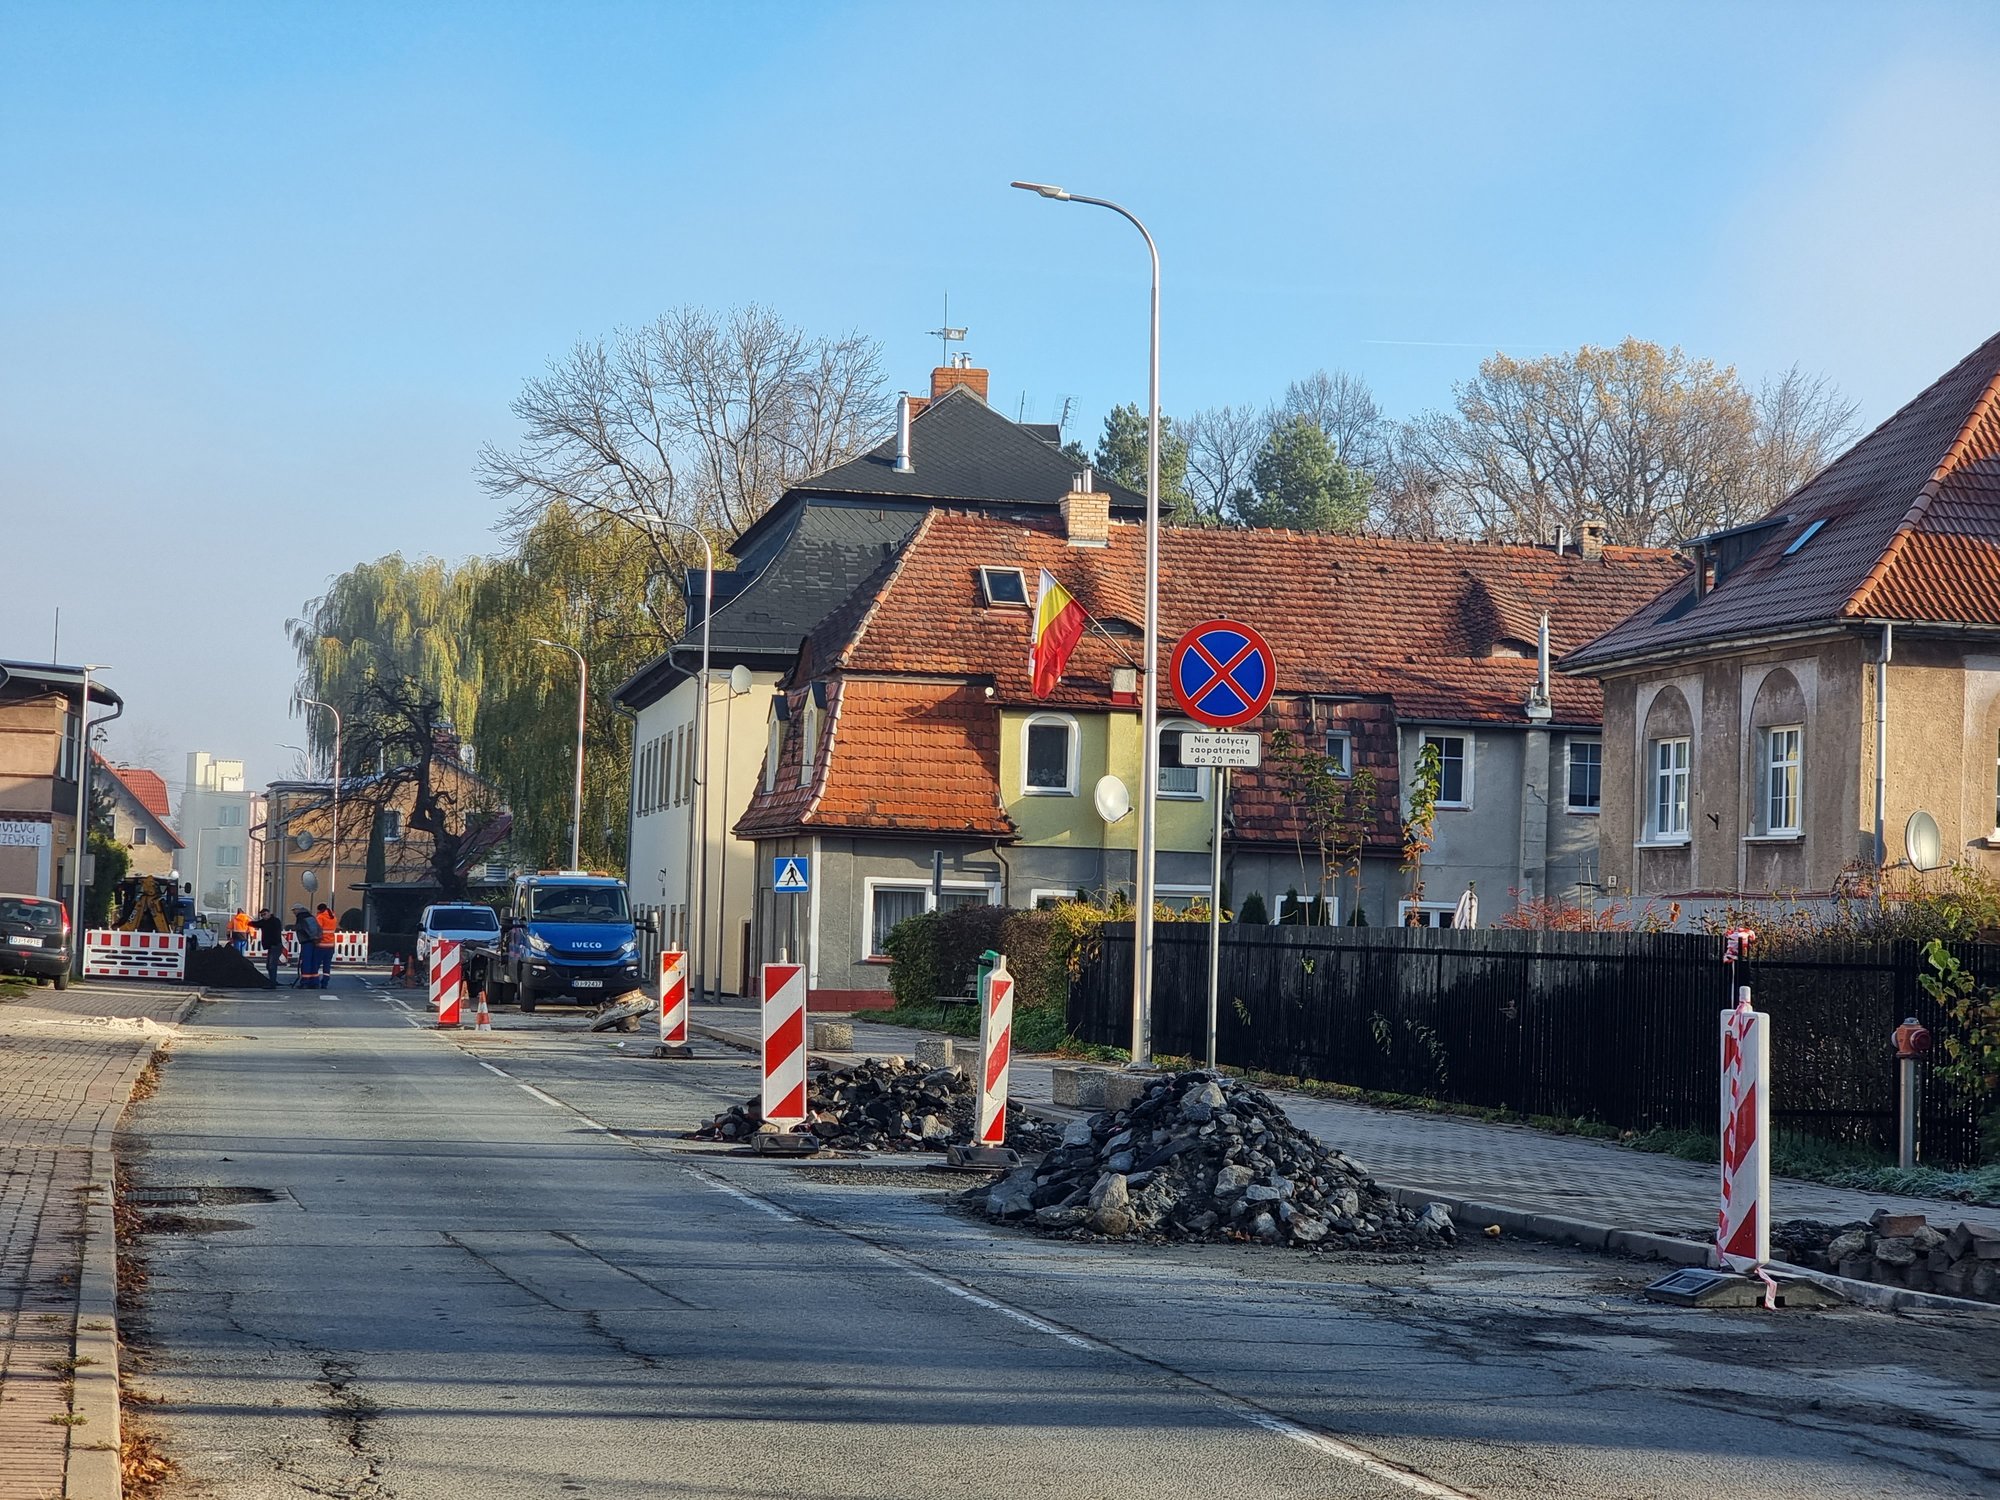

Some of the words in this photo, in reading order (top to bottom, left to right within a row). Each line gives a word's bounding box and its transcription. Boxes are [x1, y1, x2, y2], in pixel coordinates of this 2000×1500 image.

[1194, 735, 1210, 744] Nie
[1214, 736, 1249, 746] dotyczy
[1190, 746, 1250, 755] zaopatrzenia
[1194, 755, 1206, 763] do
[1211, 755, 1223, 764] 20
[1228, 756, 1248, 765] min.
[0, 833, 41, 845] ZEWSKIE
[571, 941, 602, 949] IVECO
